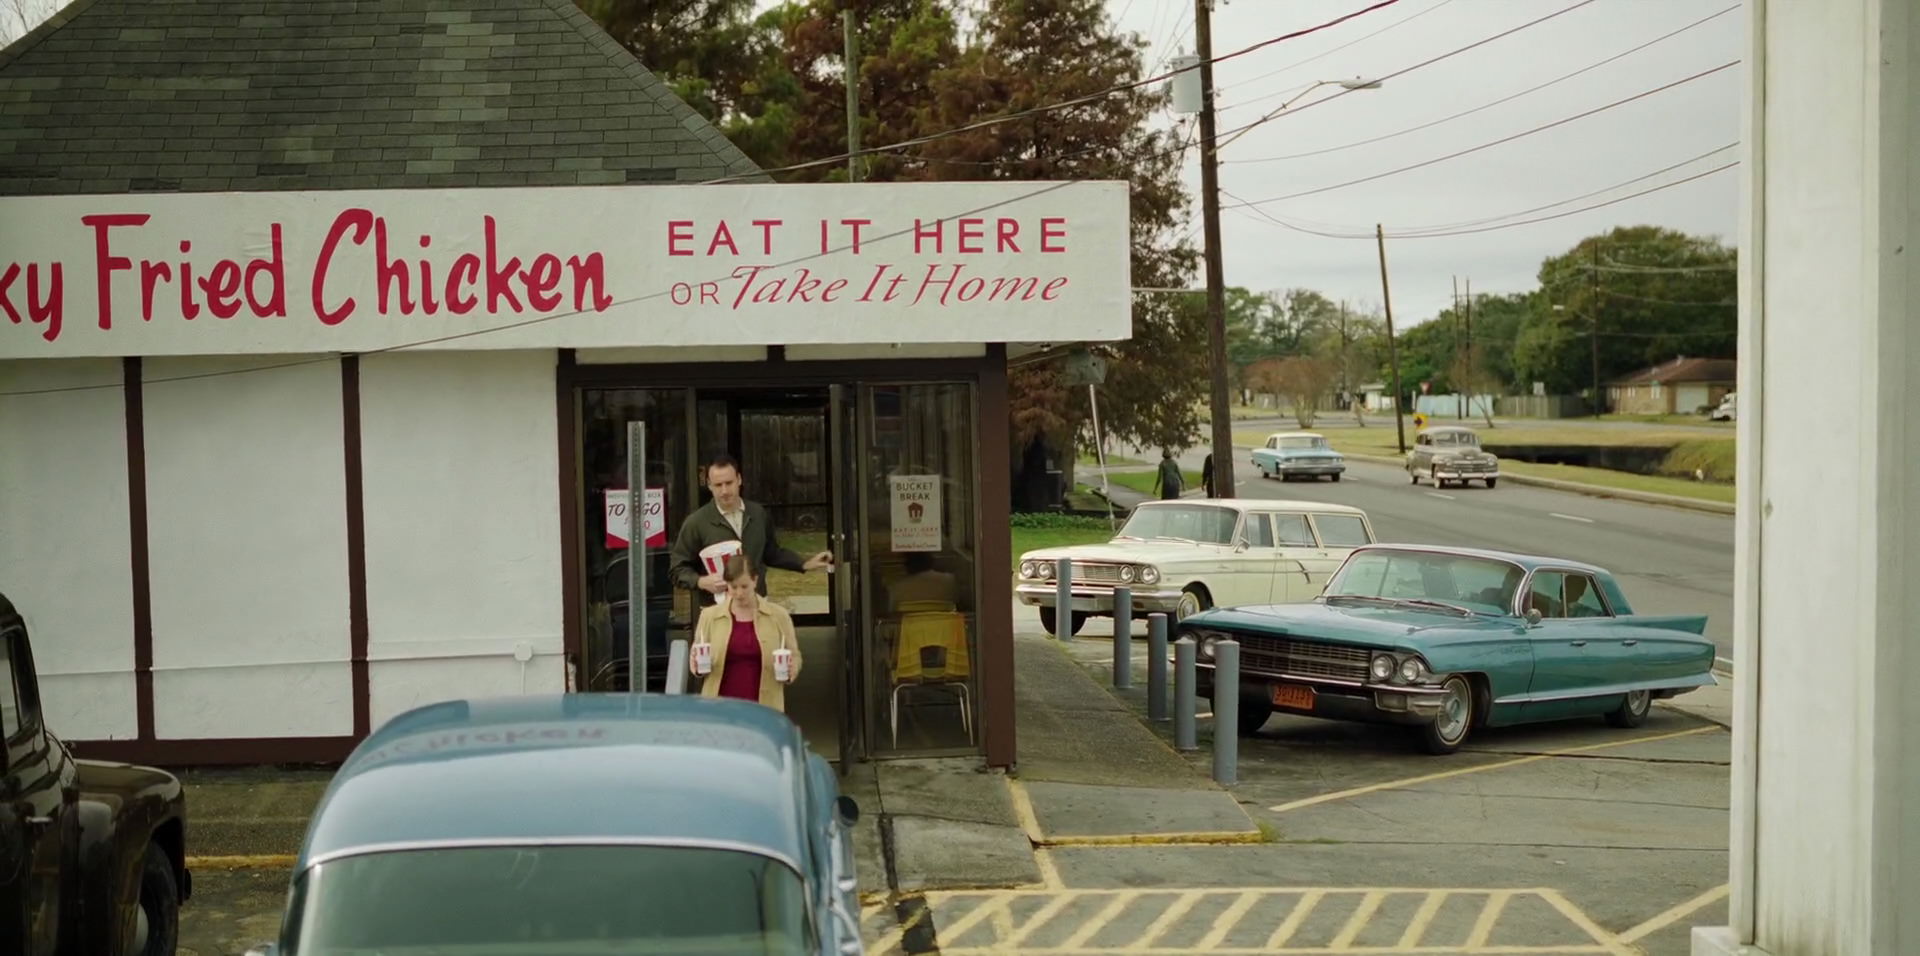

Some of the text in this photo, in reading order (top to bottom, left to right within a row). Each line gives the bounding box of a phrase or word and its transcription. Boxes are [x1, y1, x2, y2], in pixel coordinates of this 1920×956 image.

[668, 217, 1068, 257] EAT IT HERE
[81, 213, 287, 331] Fried
[312, 207, 613, 327] Chicken
[670, 263, 1069, 310] OR Take It Home
[896, 482, 933, 491] BUCKET
[900, 492, 930, 502] BREAK
[608, 502, 662, 517] TO GO
